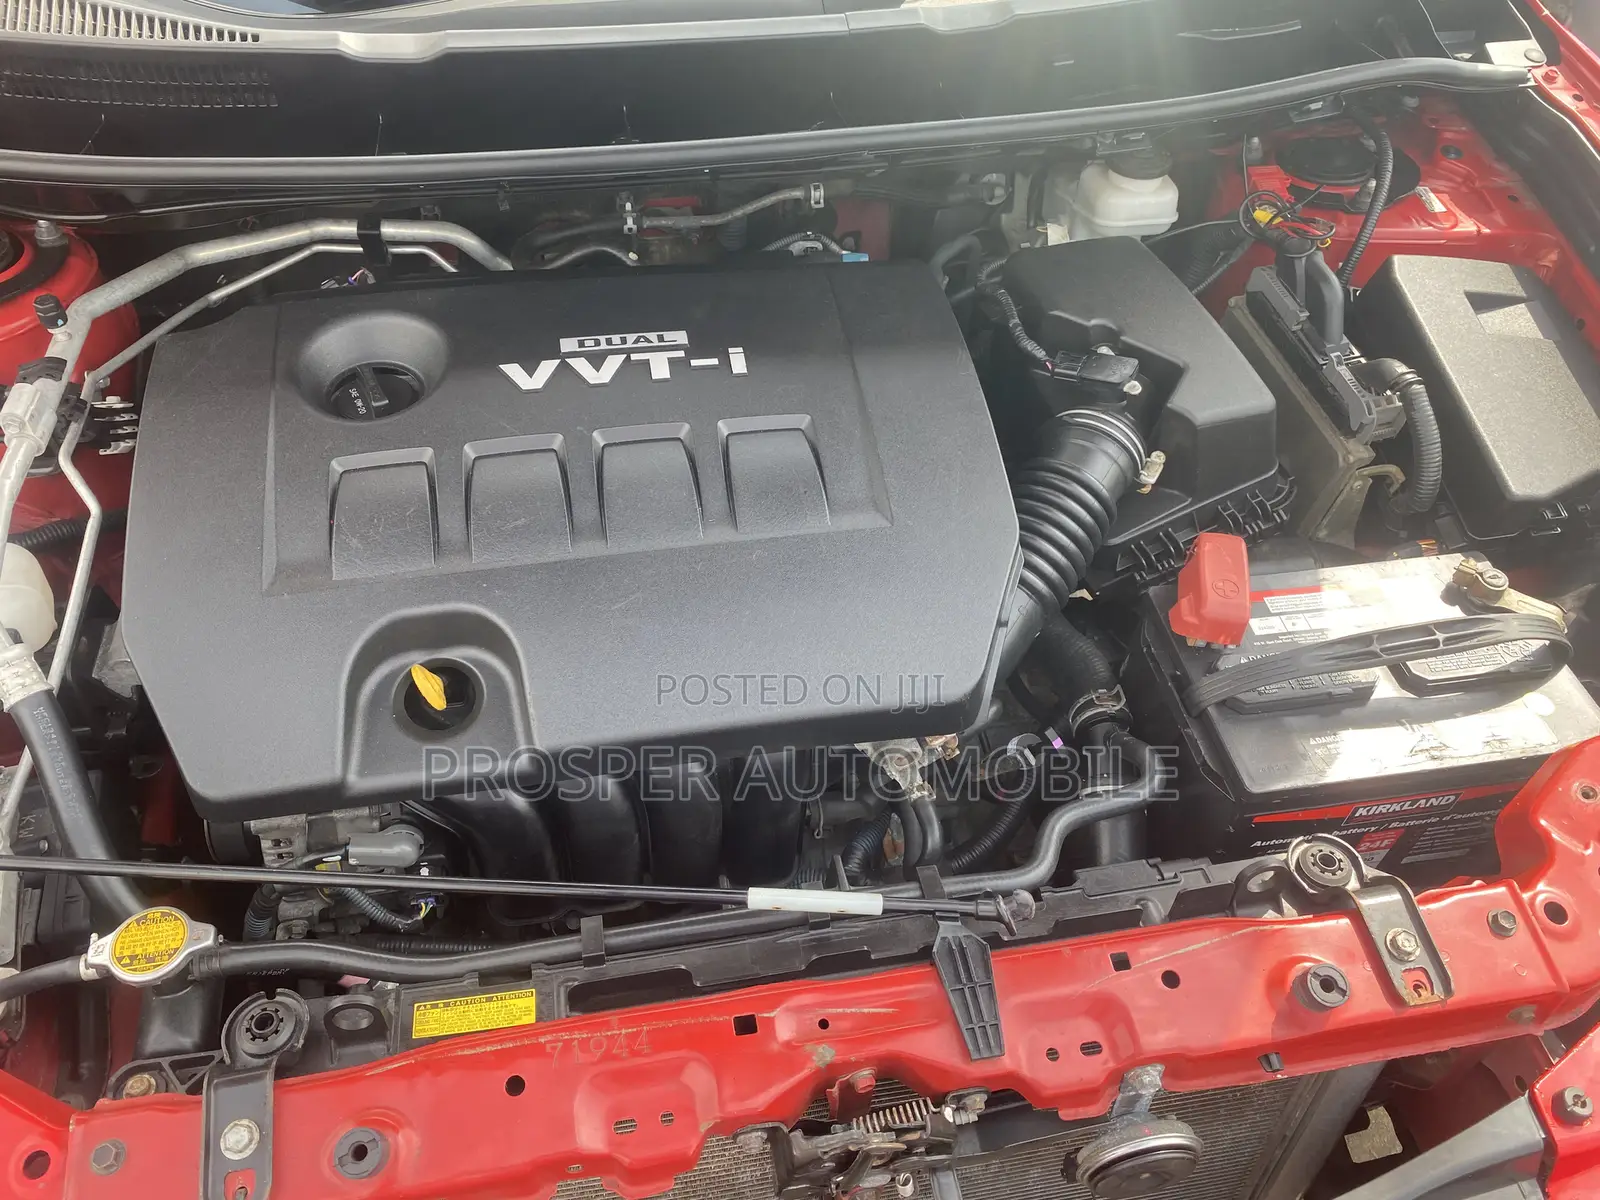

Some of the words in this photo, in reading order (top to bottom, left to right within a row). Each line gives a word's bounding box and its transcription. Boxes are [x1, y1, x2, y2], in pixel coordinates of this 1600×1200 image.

[577, 334, 678, 348] DUAL
[498, 346, 748, 392] VVT-i
[1354, 795, 1456, 817] KIRKLAND
[1332, 825, 1379, 836] battery
[1388, 817, 1440, 829] Batterie
[1359, 838, 1395, 851] 24F
[140, 915, 175, 926] CAUTION
[137, 949, 174, 960] ATTENTION
[450, 998, 486, 1007] CAUTION
[492, 991, 532, 1001] ATTENTION
[545, 1026, 652, 1070] 71944
